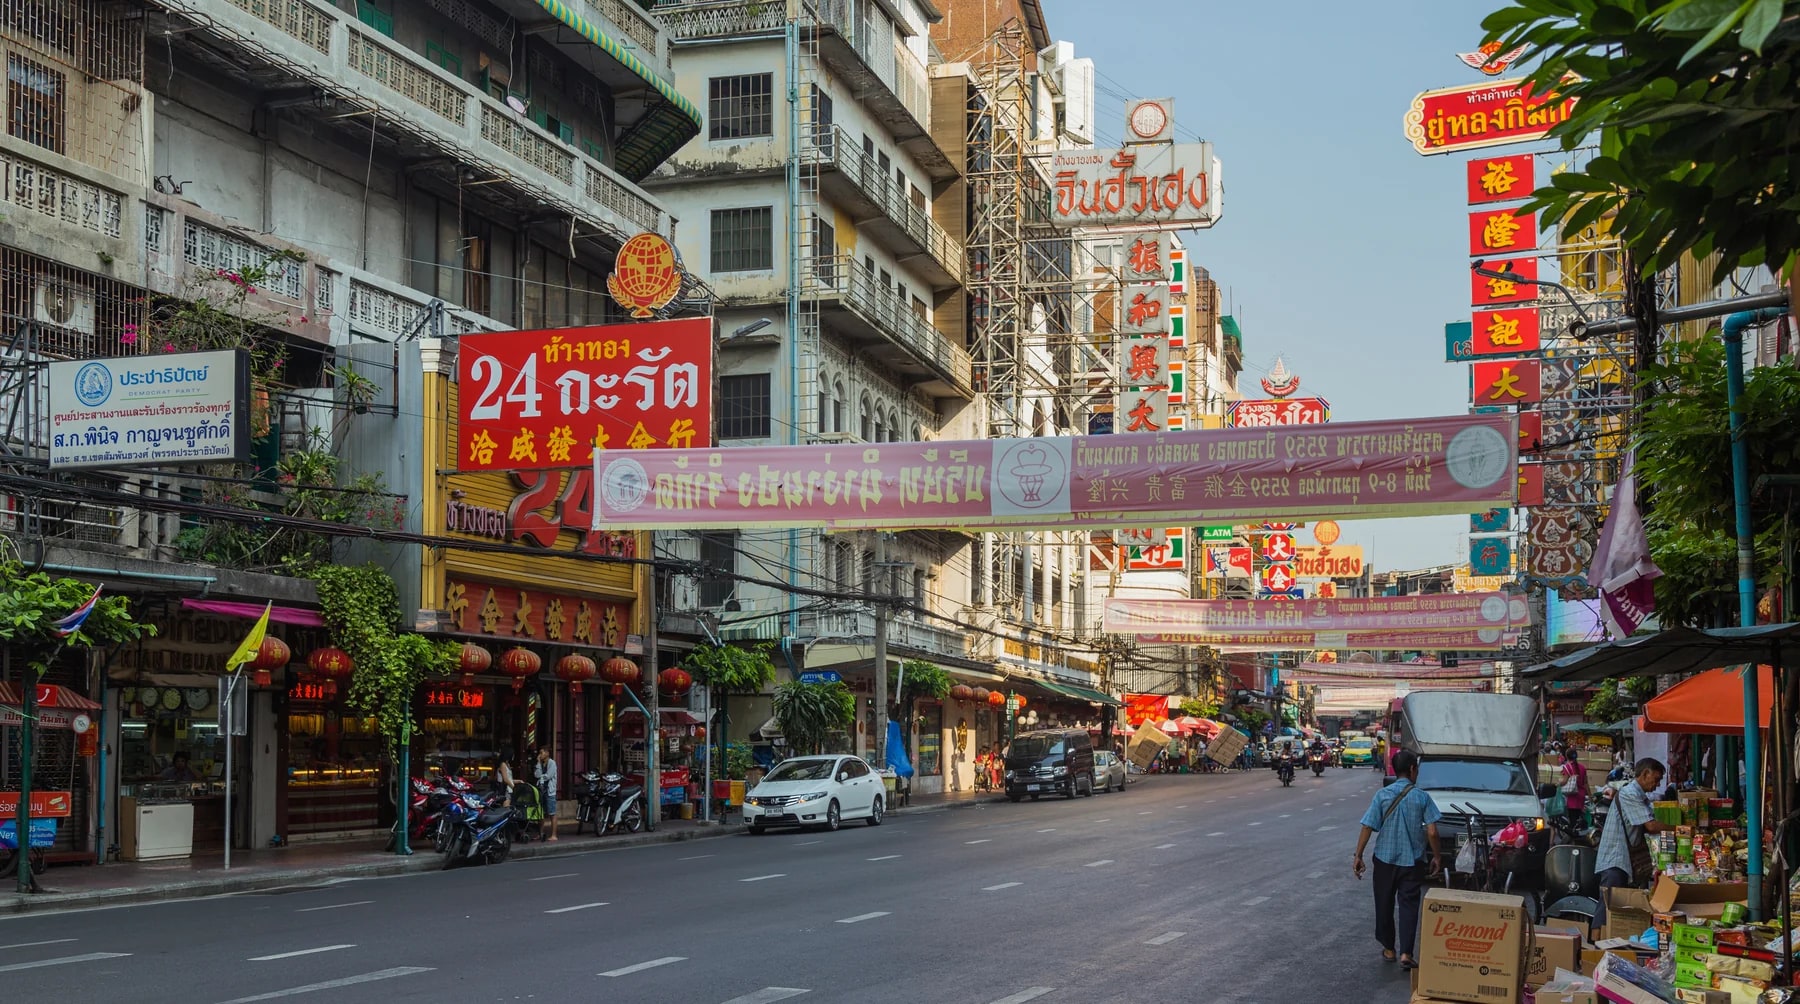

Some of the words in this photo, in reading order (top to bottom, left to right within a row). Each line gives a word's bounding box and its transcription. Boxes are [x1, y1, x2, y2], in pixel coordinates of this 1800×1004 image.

[542, 335, 631, 364] ห้างทอง
[119, 365, 210, 386] ประชาธิปัตย์
[470, 352, 543, 421] 24
[555, 346, 699, 416] กะรัต
[128, 388, 171, 397] DEMOCRAT
[175, 387, 201, 396] PARTY
[1238, 402, 1278, 414] ห้างทอง
[54, 425, 119, 448] ส.ก.พินิจ
[126, 412, 232, 448] กาญจนชูศักดิ์
[53, 455, 70, 464] และ
[1231, 552, 1249, 564] KFC
[830, 673, 836, 682] 8
[1432, 916, 1508, 940] Le-mond
